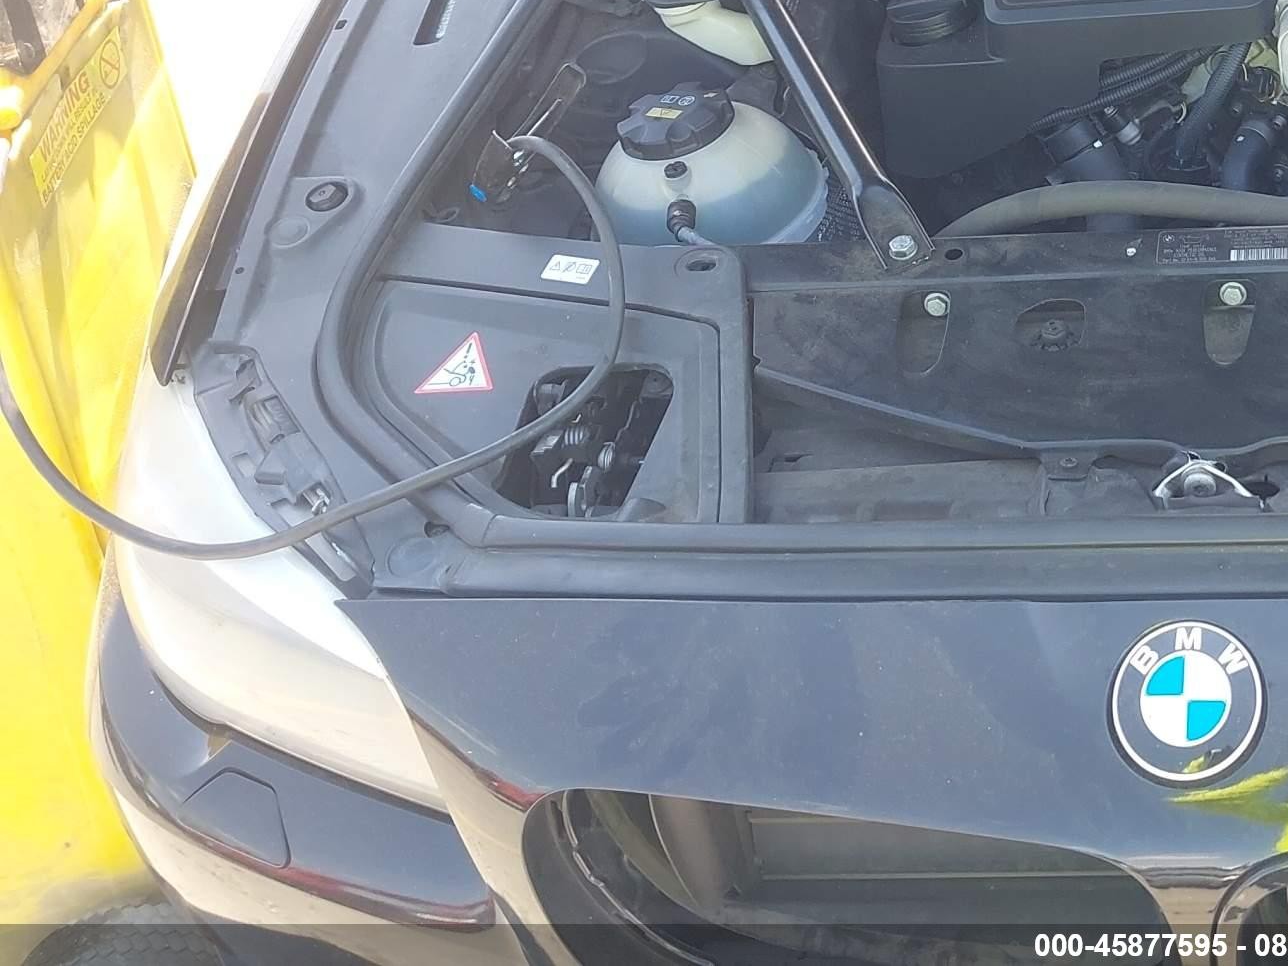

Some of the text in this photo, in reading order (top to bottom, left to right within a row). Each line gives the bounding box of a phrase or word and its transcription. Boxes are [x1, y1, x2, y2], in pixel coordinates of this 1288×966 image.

[38, 70, 90, 163] WARNING
[76, 92, 106, 138] SPILLAGE
[1129, 626, 1249, 675] BMW
